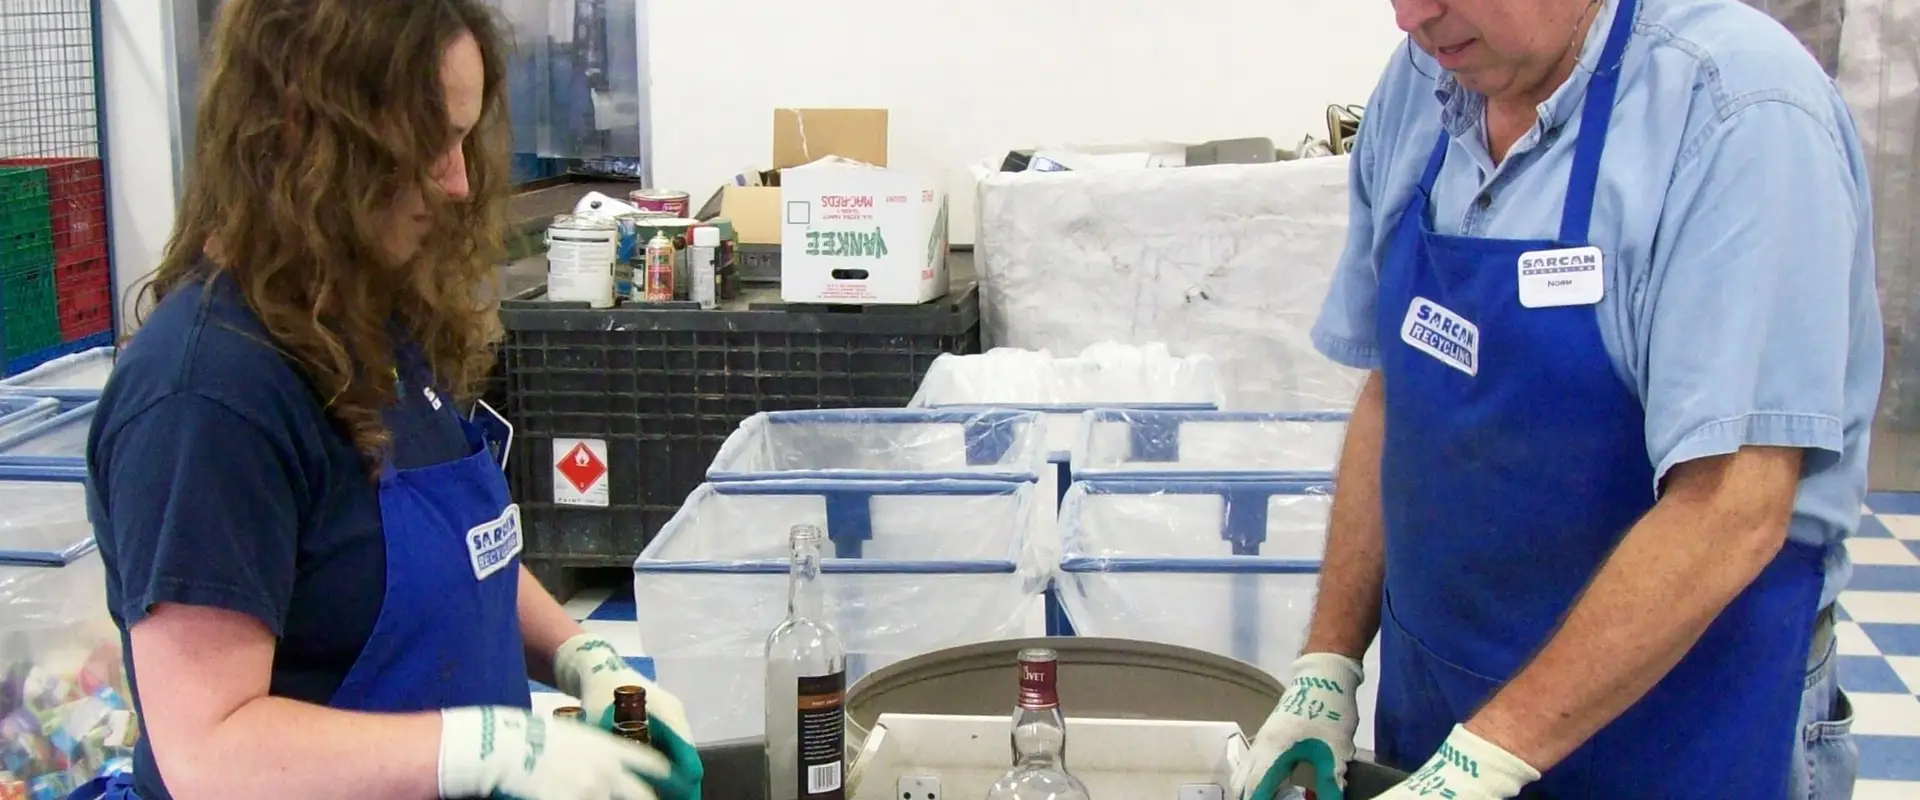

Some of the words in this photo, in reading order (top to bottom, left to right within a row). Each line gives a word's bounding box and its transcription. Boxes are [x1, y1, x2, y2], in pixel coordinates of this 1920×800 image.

[805, 226, 888, 259] YANKEE
[1522, 254, 1595, 268] SARCAN
[1411, 324, 1472, 367] RECYCLING
[1417, 304, 1474, 349] SARCAN
